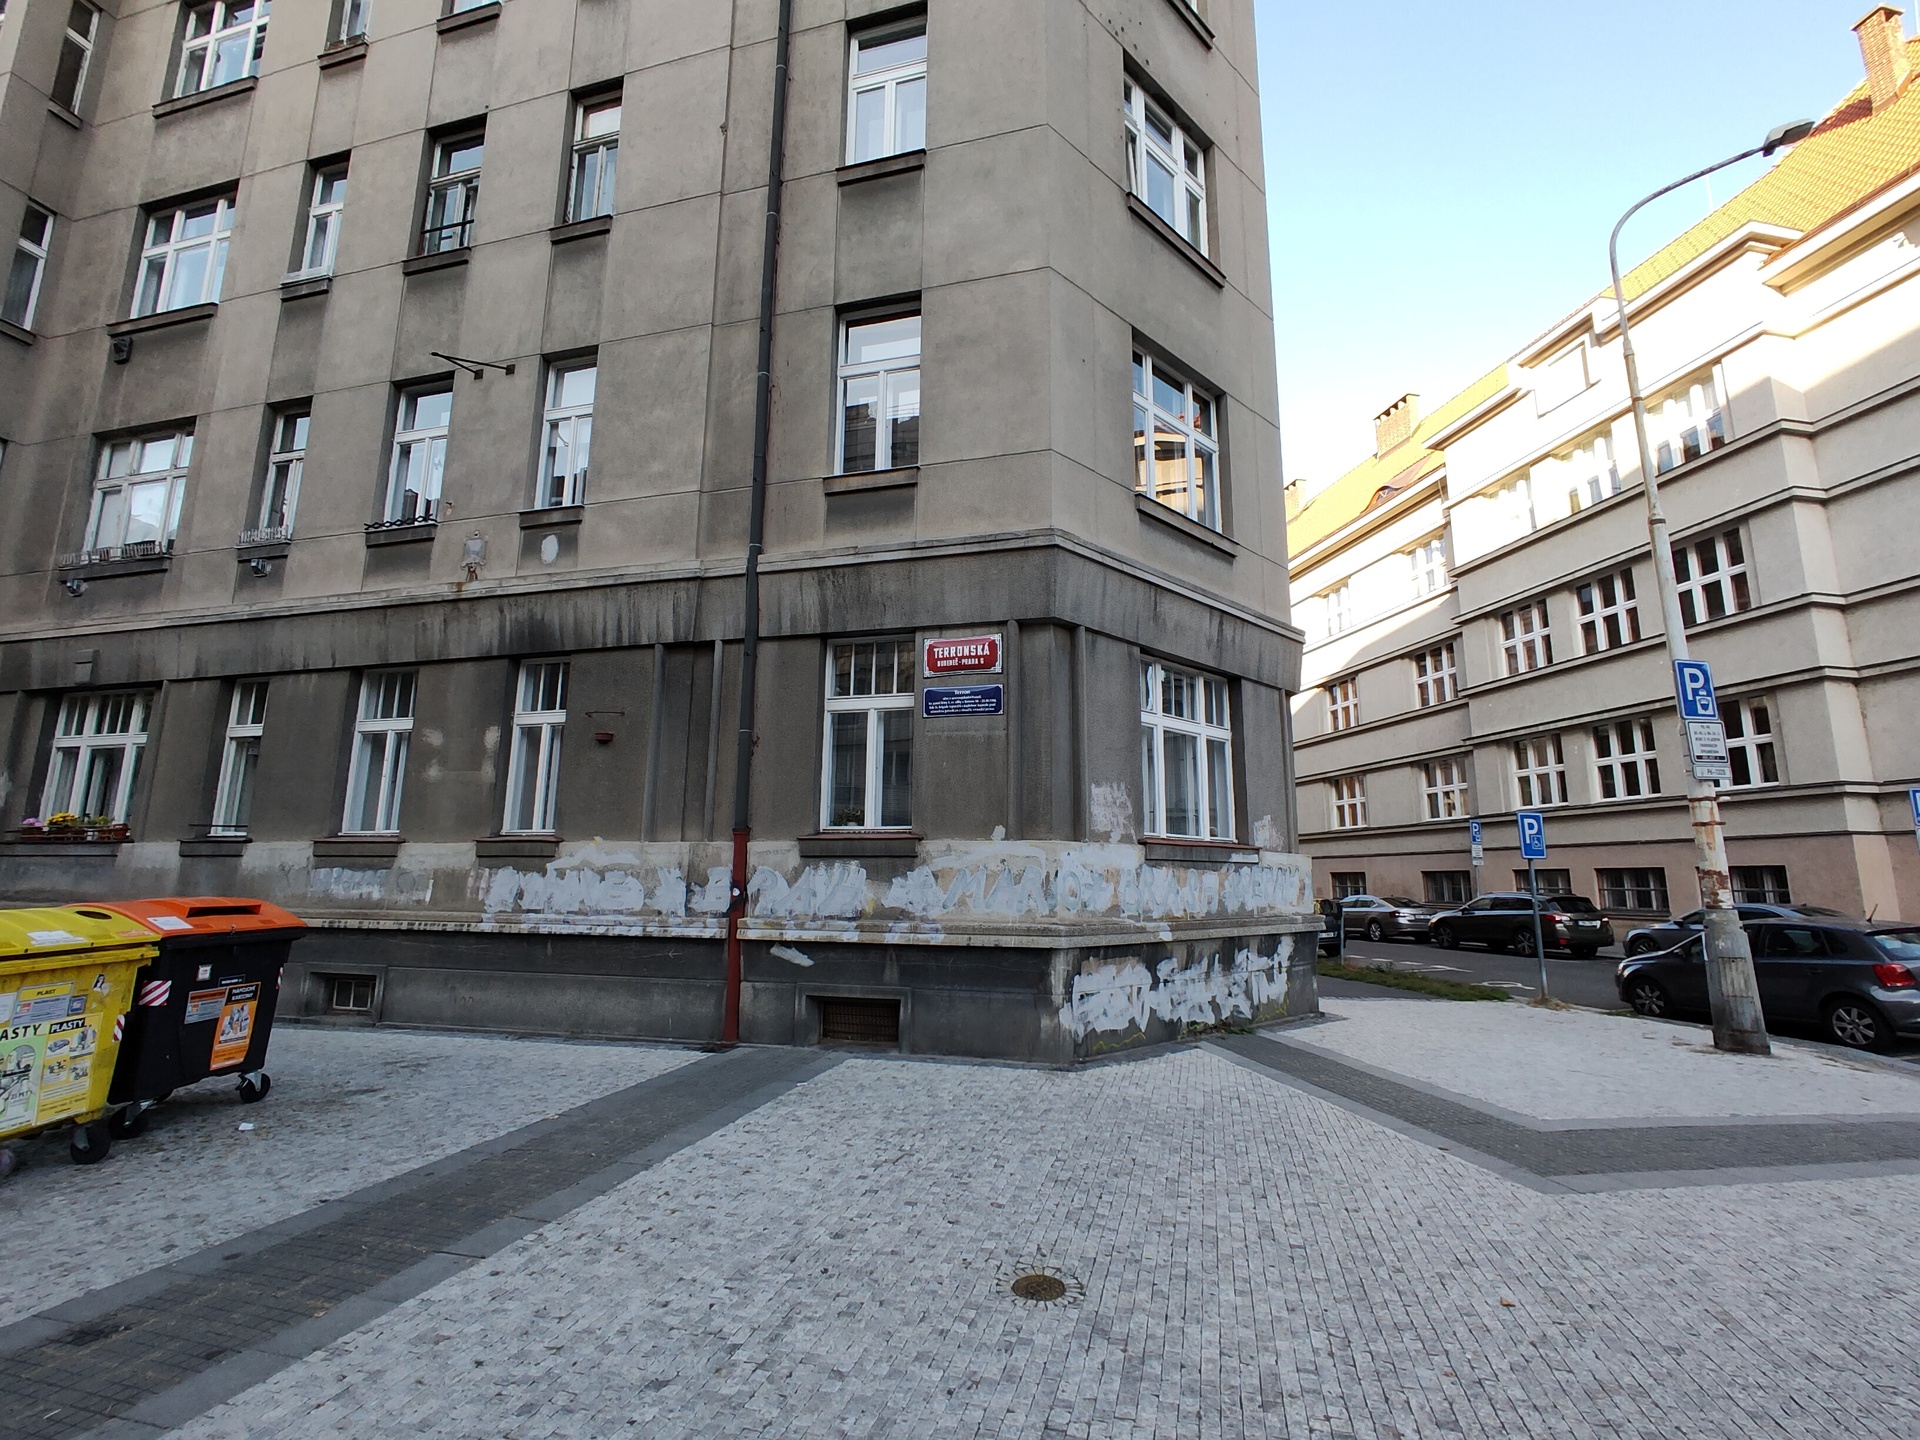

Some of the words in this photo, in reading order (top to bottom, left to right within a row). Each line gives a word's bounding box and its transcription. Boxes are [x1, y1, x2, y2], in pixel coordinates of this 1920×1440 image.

[933, 642, 990, 659] TERRONSKÁ
[1684, 668, 1704, 700] P
[1472, 823, 1479, 836] P
[1523, 818, 1538, 844] P
[36, 988, 56, 996] PLAST
[50, 1019, 84, 1035] PLASTY
